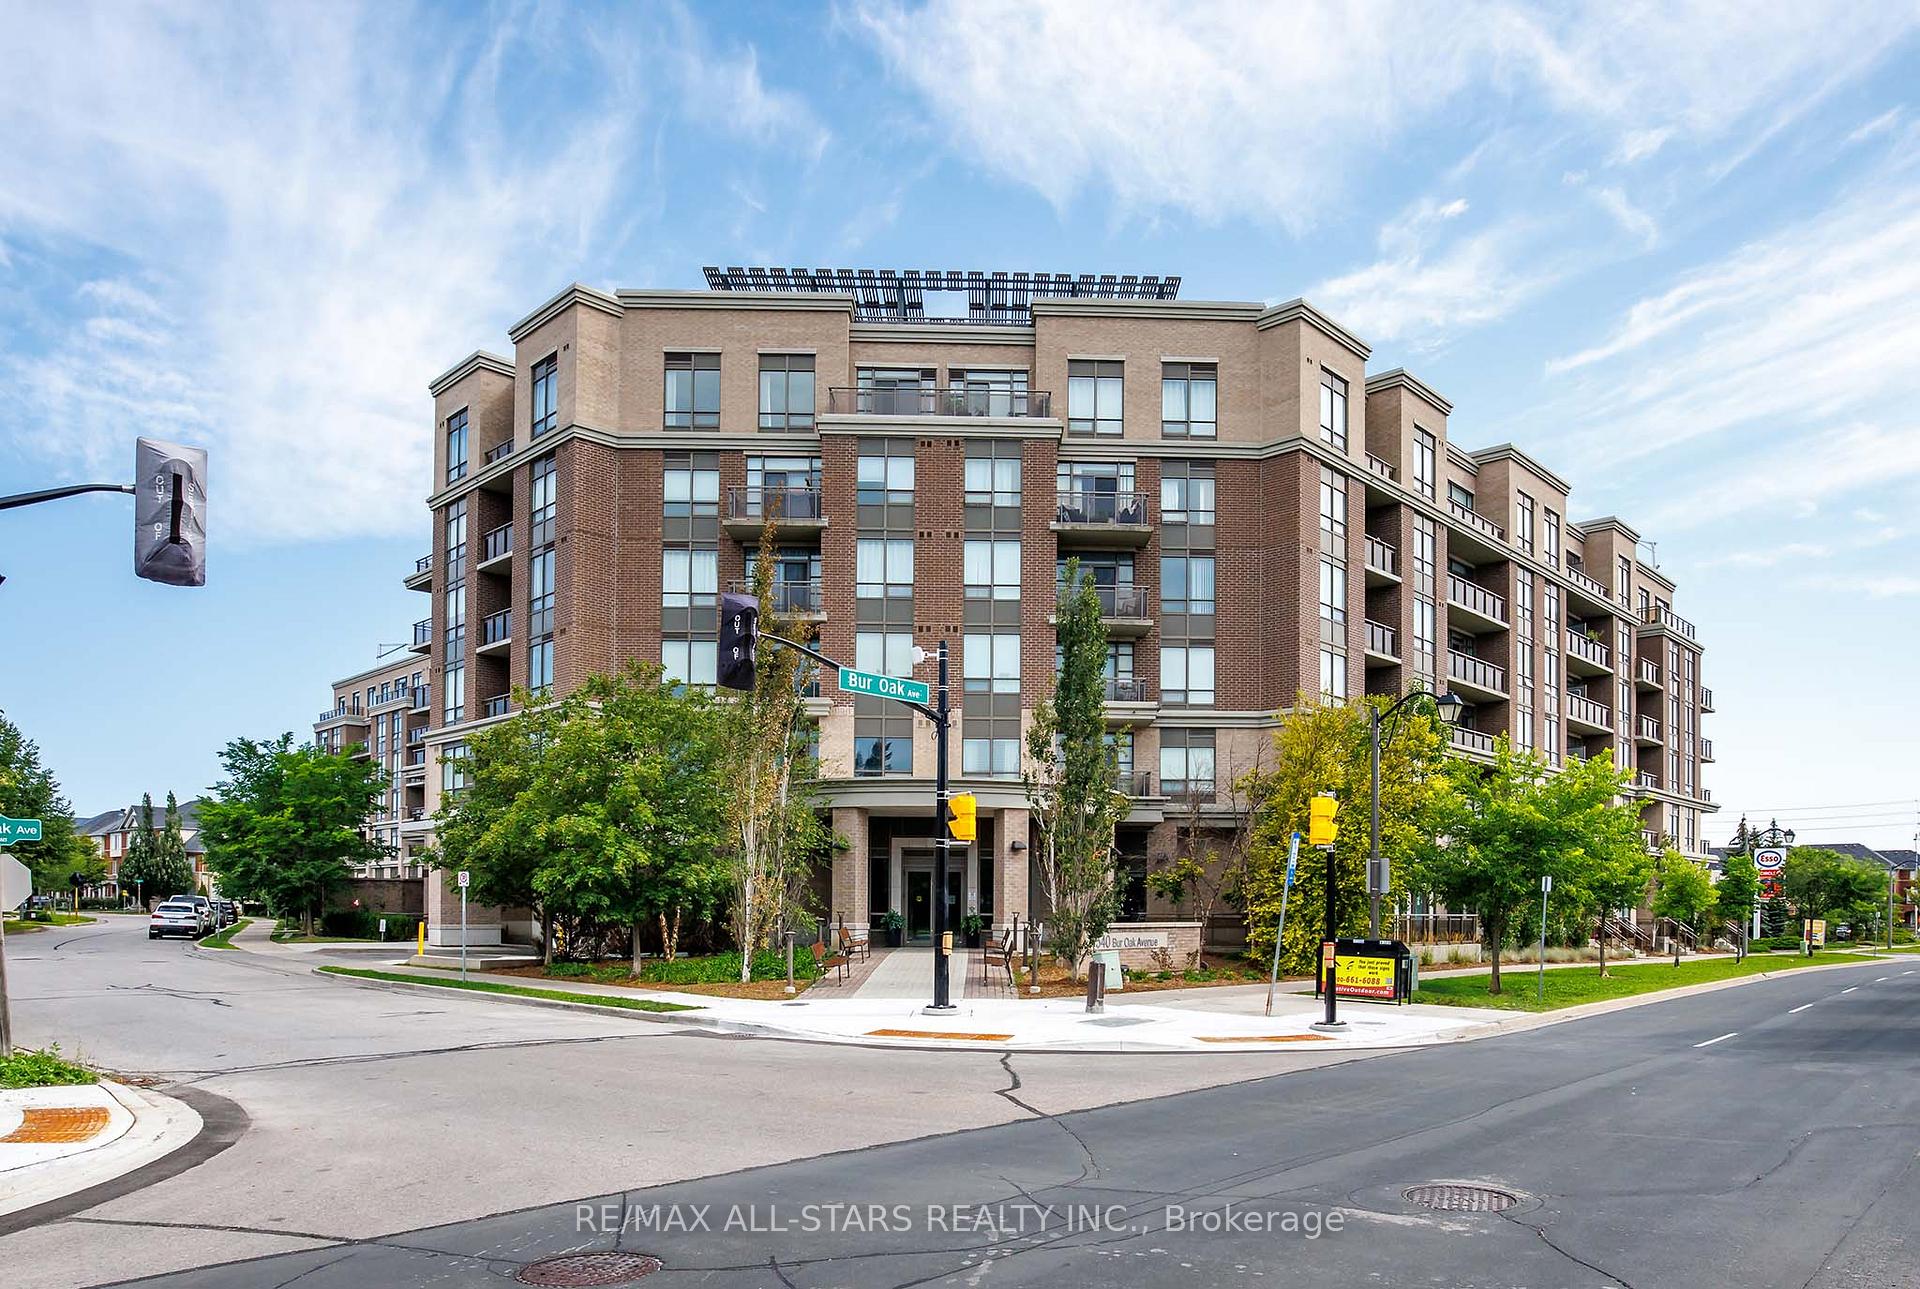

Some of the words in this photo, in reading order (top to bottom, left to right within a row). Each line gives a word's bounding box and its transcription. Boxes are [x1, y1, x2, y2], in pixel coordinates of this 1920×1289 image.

[155, 475, 165, 503] OUT
[153, 522, 163, 541] OF
[733, 614, 741, 635] OUT
[732, 646, 740, 660] OF
[848, 672, 873, 690] Bur
[879, 678, 905, 696] Oak
[907, 689, 921, 699] Ave
[16, 825, 38, 835] Ave
[1760, 855, 1779, 863] Esso
[1112, 937, 1123, 948] Bur
[1124, 936, 1136, 948] Oak
[1137, 937, 1159, 947] Avenue
